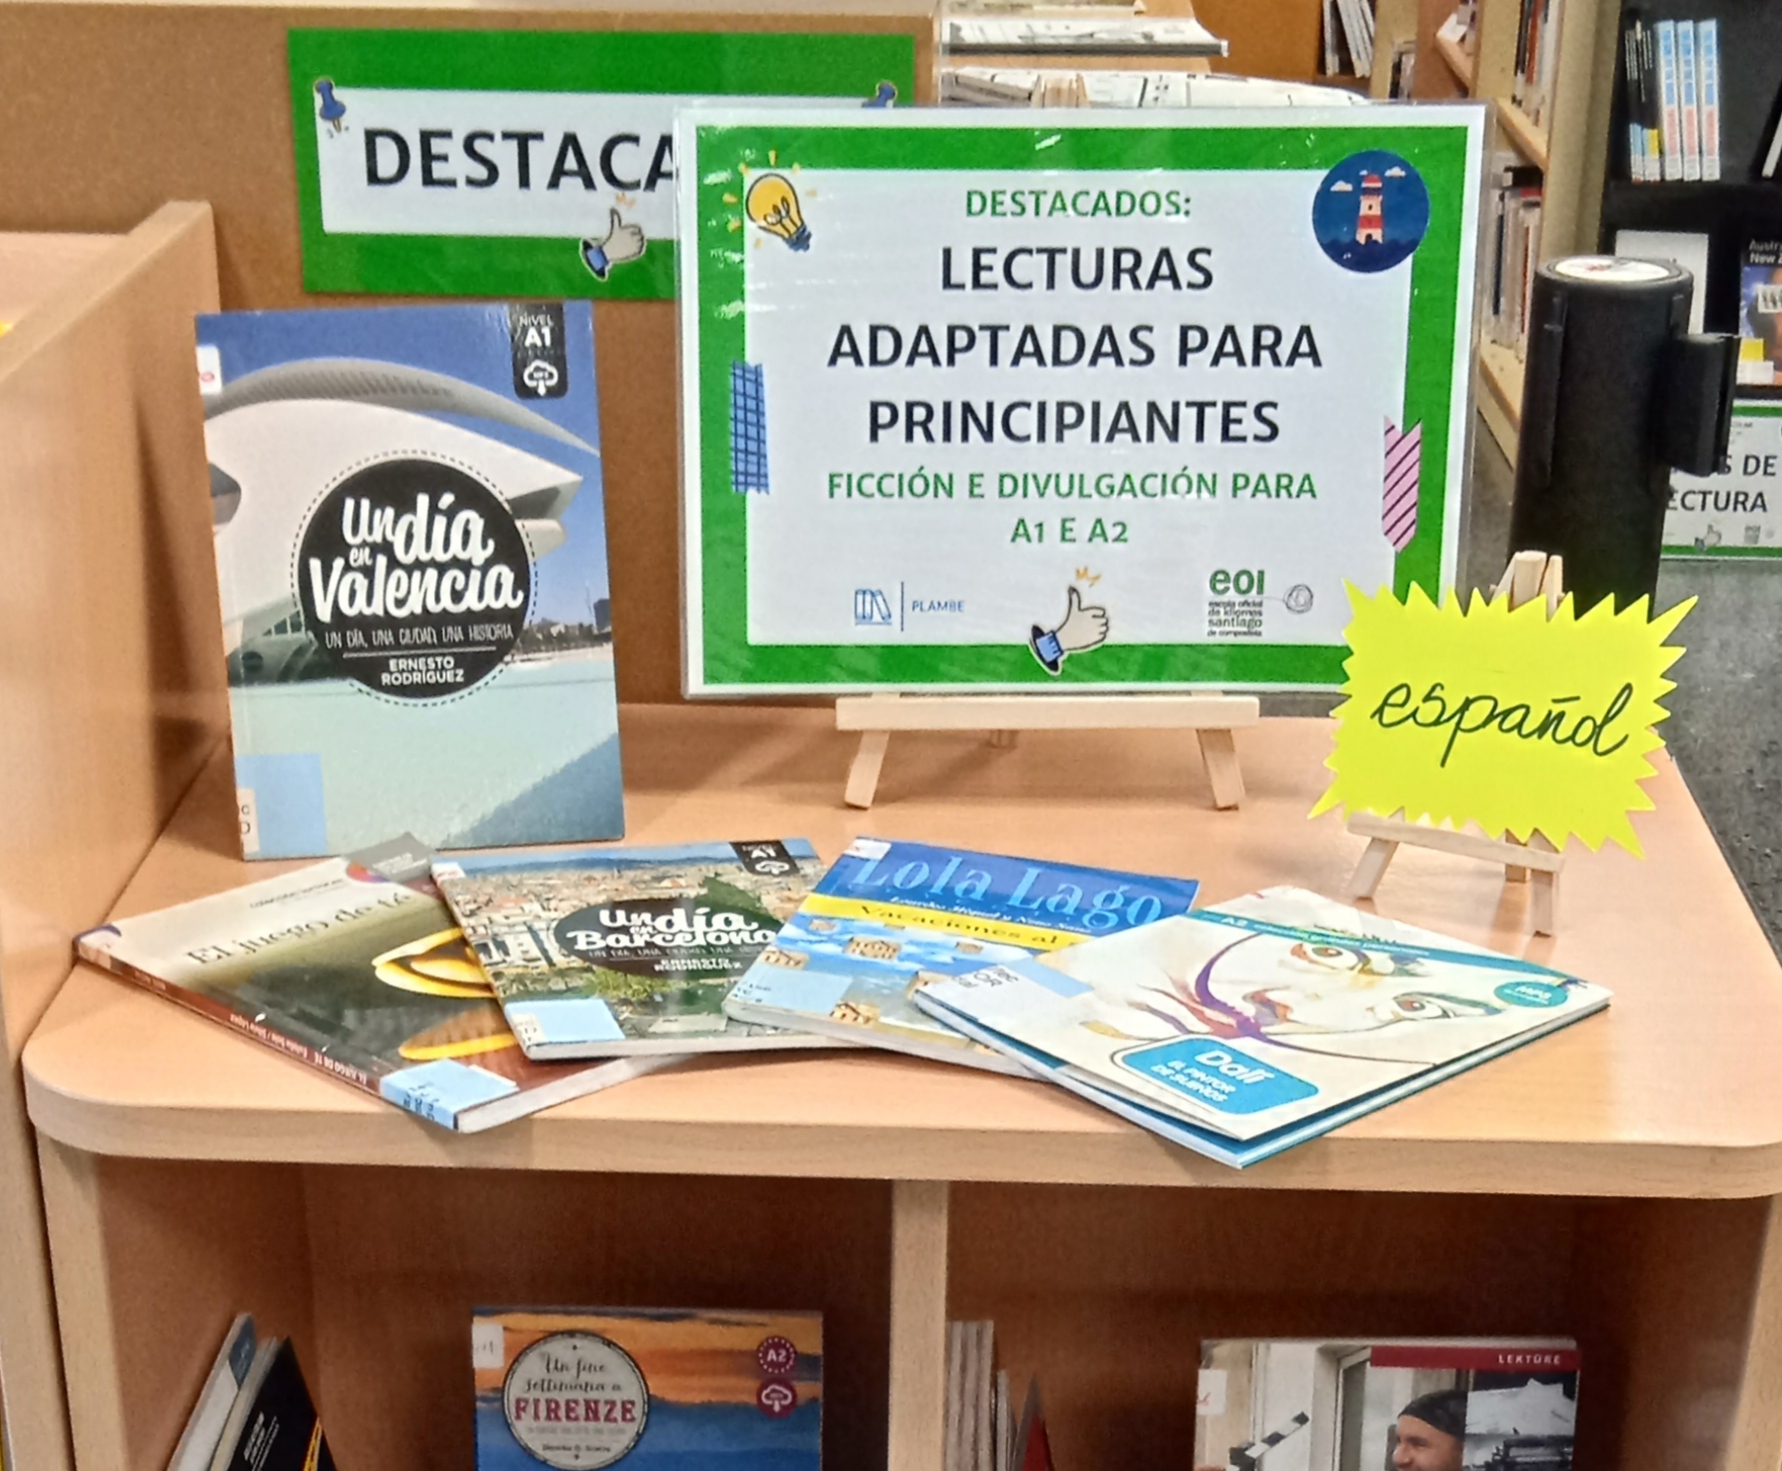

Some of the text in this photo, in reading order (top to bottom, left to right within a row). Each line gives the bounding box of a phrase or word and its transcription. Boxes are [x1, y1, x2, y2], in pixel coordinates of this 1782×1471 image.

[965, 187, 1191, 218] DESTACADOS:
[940, 245, 1214, 293] LECTURAS
[524, 325, 552, 348] A1
[827, 322, 1324, 369] ADAPTADAS PARA
[867, 399, 1281, 445] PRINCIPIANTES
[1742, 454, 1778, 477] DE
[827, 464, 1317, 501] FICCIÓN E DIVULGACIÓN PARA
[342, 491, 496, 567] Un día
[1009, 517, 1130, 545] A1 E A2
[348, 546, 373, 568] en
[308, 553, 525, 624] Valencia
[1208, 568, 1266, 596] eoi
[911, 599, 966, 613] PLAMBE
[325, 632, 342, 649] UN
[371, 628, 395, 647] UNA
[441, 625, 464, 643] UNA
[1207, 617, 1263, 632] santiago
[380, 668, 465, 686] RODRÍGUEZ
[388, 655, 455, 673] ERNESTO
[1371, 682, 1634, 769] español
[848, 855, 1164, 931] Lola Lago
[598, 906, 760, 934] Un día
[859, 903, 1031, 941] Vacaciones
[1219, 916, 1250, 928] A2
[185, 943, 233, 965] El
[232, 918, 331, 956] juego
[565, 927, 779, 951] Barcelona
[1182, 1067, 1237, 1094] PINTOR
[1193, 1049, 1276, 1085] Dalí
[766, 1348, 788, 1363] A2
[513, 1397, 638, 1425] FIRENZE
